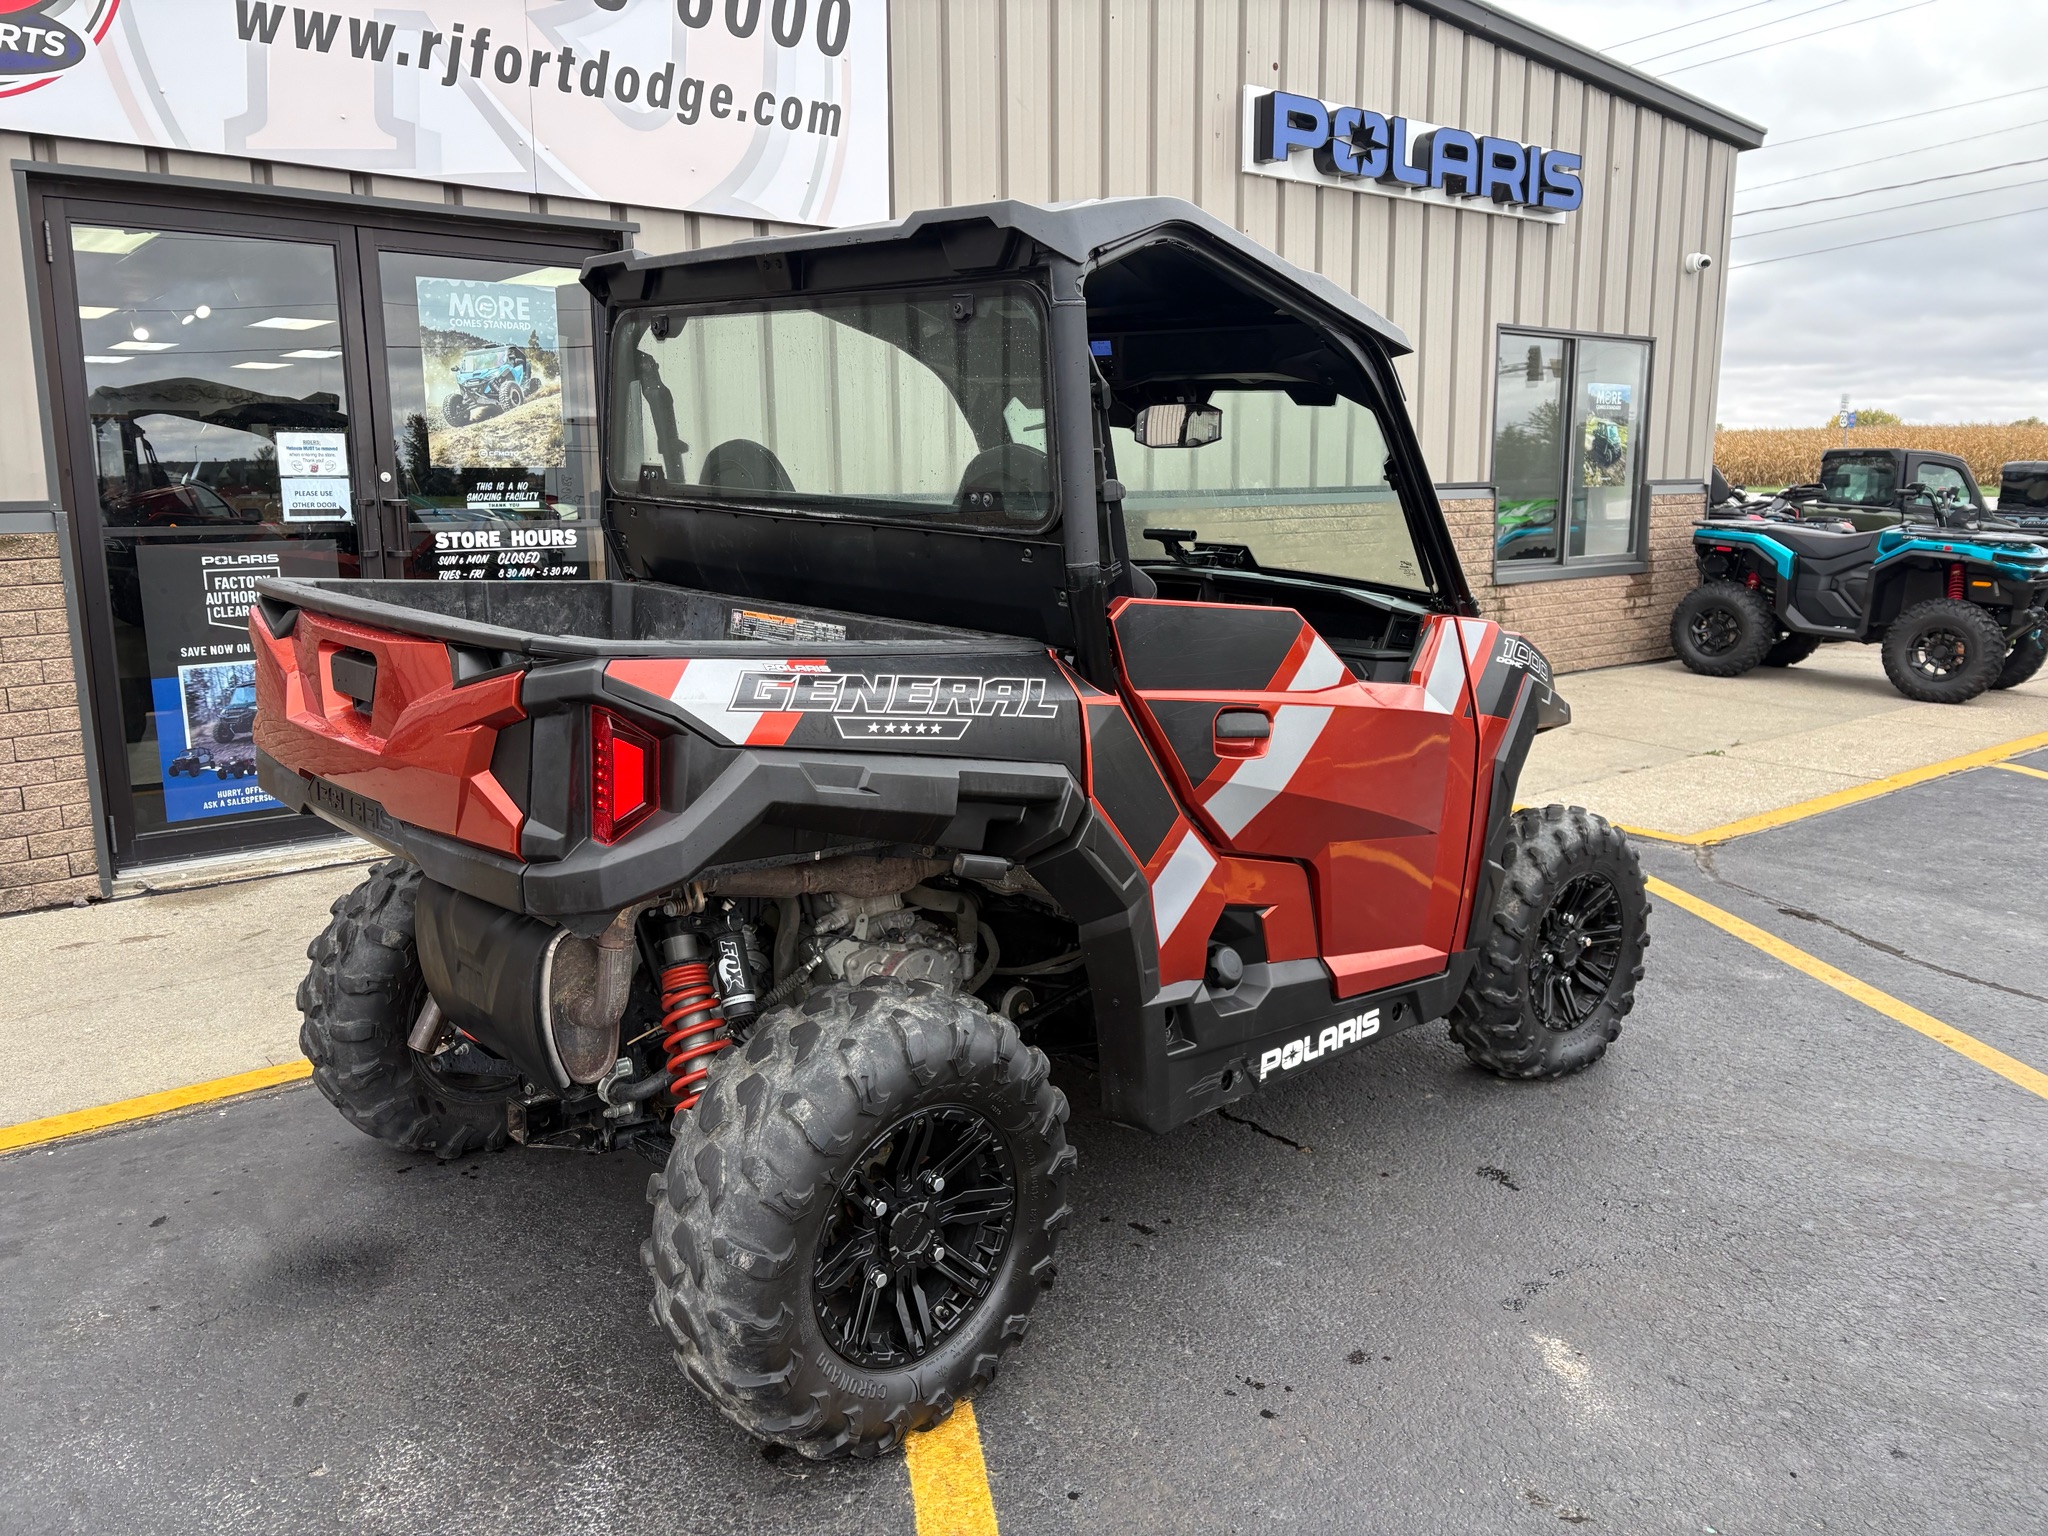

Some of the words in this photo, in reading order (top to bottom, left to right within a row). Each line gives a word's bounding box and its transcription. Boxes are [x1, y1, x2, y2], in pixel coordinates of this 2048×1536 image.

[236, 0, 842, 137] www.rjfortdodge.com
[1255, 91, 1584, 212] POLARIS
[449, 292, 531, 320] MORE
[449, 318, 482, 328] COMES
[484, 320, 531, 331] STANDARD
[1596, 391, 1622, 404] MORE
[476, 482, 493, 490] THIS
[497, 482, 504, 490] IS
[508, 482, 513, 490] A
[517, 482, 528, 490] NO
[467, 493, 502, 501] SMOKING
[505, 491, 538, 500] FACILITY
[435, 531, 500, 549] STORE
[511, 528, 577, 546] HOURS
[202, 554, 279, 565] POLARIS
[438, 555, 458, 566] SUN
[466, 554, 489, 564] MON
[497, 552, 540, 564] CLOSED
[438, 569, 461, 580] TUES
[469, 569, 485, 579] FRI
[519, 567, 535, 577] AM
[562, 566, 577, 575] PM
[181, 646, 207, 657] SAVE
[210, 644, 233, 655] NOW
[237, 643, 250, 653] ON
[1504, 637, 1548, 682] 1000
[763, 662, 832, 673] POLARIS
[726, 670, 1058, 718] GENERAL
[217, 788, 243, 798] HURRY,
[203, 801, 218, 809] ASK
[719, 941, 745, 992] FOX
[1259, 1008, 1380, 1082] POLARIS
[816, 1352, 887, 1400] CORONADO
